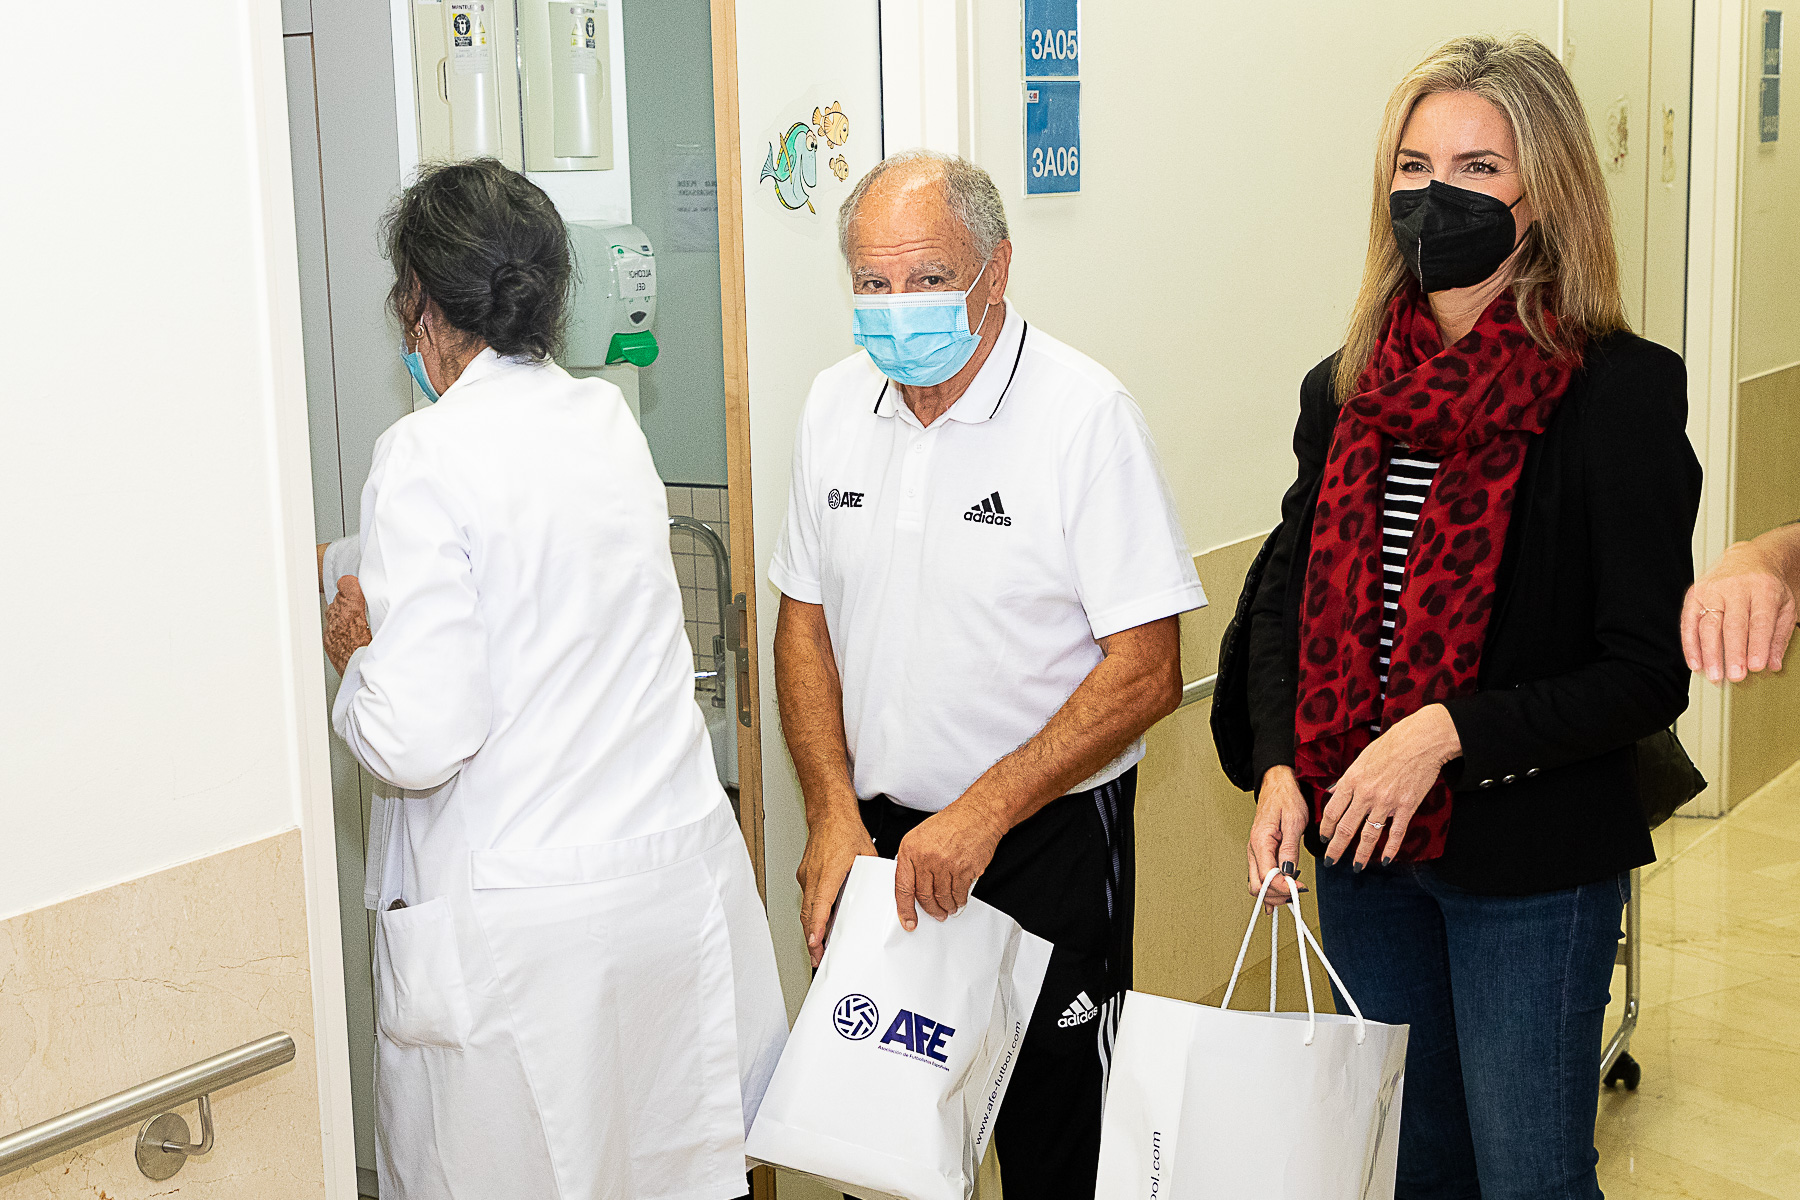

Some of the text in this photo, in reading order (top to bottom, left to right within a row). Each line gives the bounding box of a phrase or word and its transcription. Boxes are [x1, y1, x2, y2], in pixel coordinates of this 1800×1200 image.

[1031, 29, 1077, 60] 3A05
[1032, 146, 1079, 178] 3A06
[840, 491, 864, 508] AFE
[963, 510, 1012, 527] adidas
[1057, 1005, 1099, 1028] adidas
[880, 1008, 956, 1063] AFE
[976, 1021, 1021, 1146] www.afe-futbol.com
